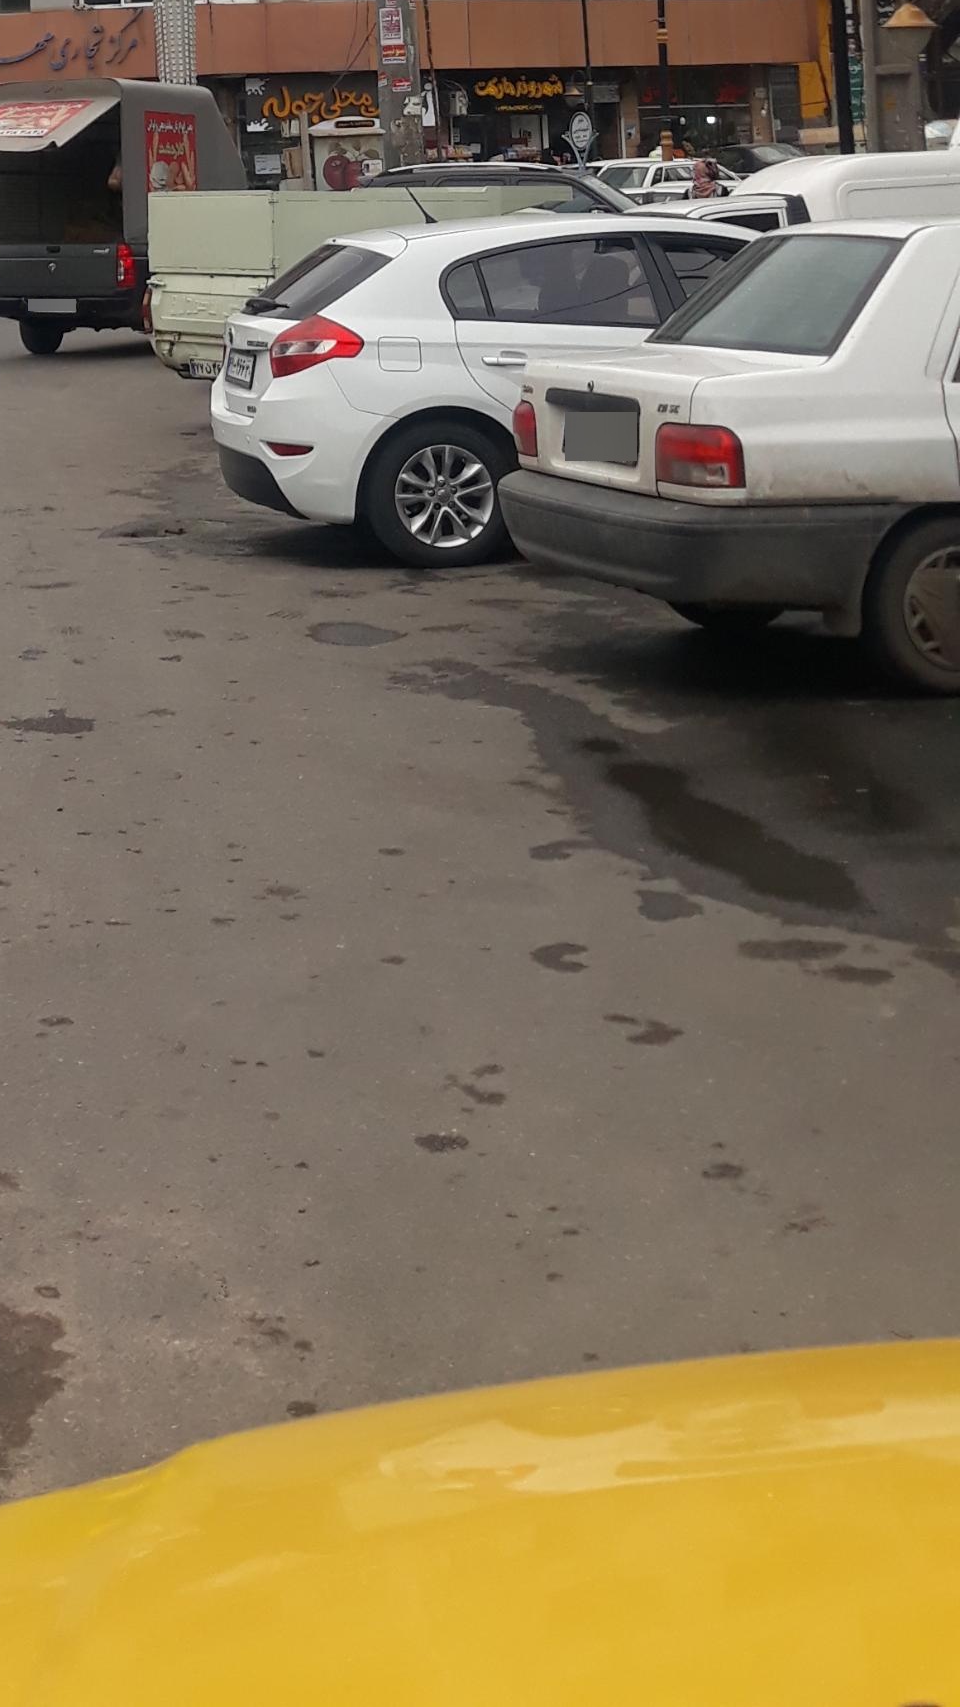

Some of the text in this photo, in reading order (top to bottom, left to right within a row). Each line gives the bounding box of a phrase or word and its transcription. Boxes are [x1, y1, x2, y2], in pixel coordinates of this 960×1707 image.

[48, 25, 105, 71] تجاری
[104, 8, 144, 65] مرکز
[320, 85, 373, 120] محلی
